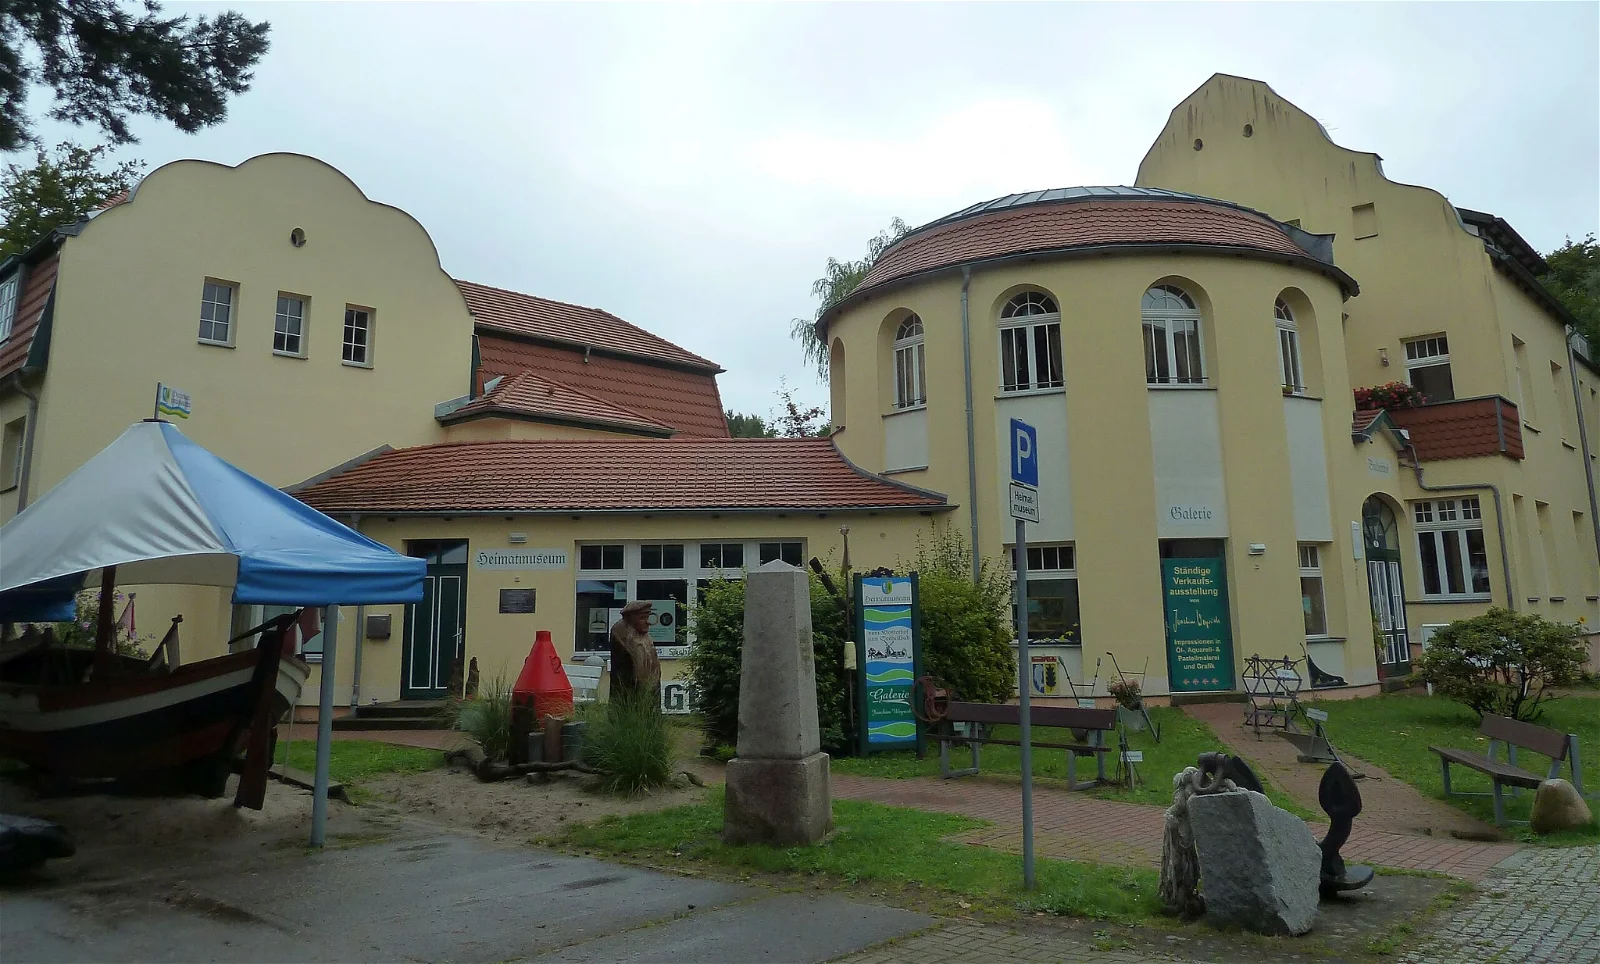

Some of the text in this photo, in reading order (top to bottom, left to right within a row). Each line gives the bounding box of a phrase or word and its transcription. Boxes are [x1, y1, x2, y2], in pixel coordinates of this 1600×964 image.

[1016, 428, 1031, 474] P
[1014, 491, 1035, 504] Heimat-
[1013, 504, 1036, 516] museum
[1170, 506, 1212, 520] Galerie
[476, 552, 566, 567] Heimatmuseum
[1173, 566, 1211, 576] Ständige
[1172, 577, 1213, 586] Verkaufs-
[1169, 587, 1219, 597] ausstellung
[1173, 638, 1215, 647] Impressionen
[1187, 646, 1215, 654] Aquarell-
[869, 688, 910, 704] Galerie
